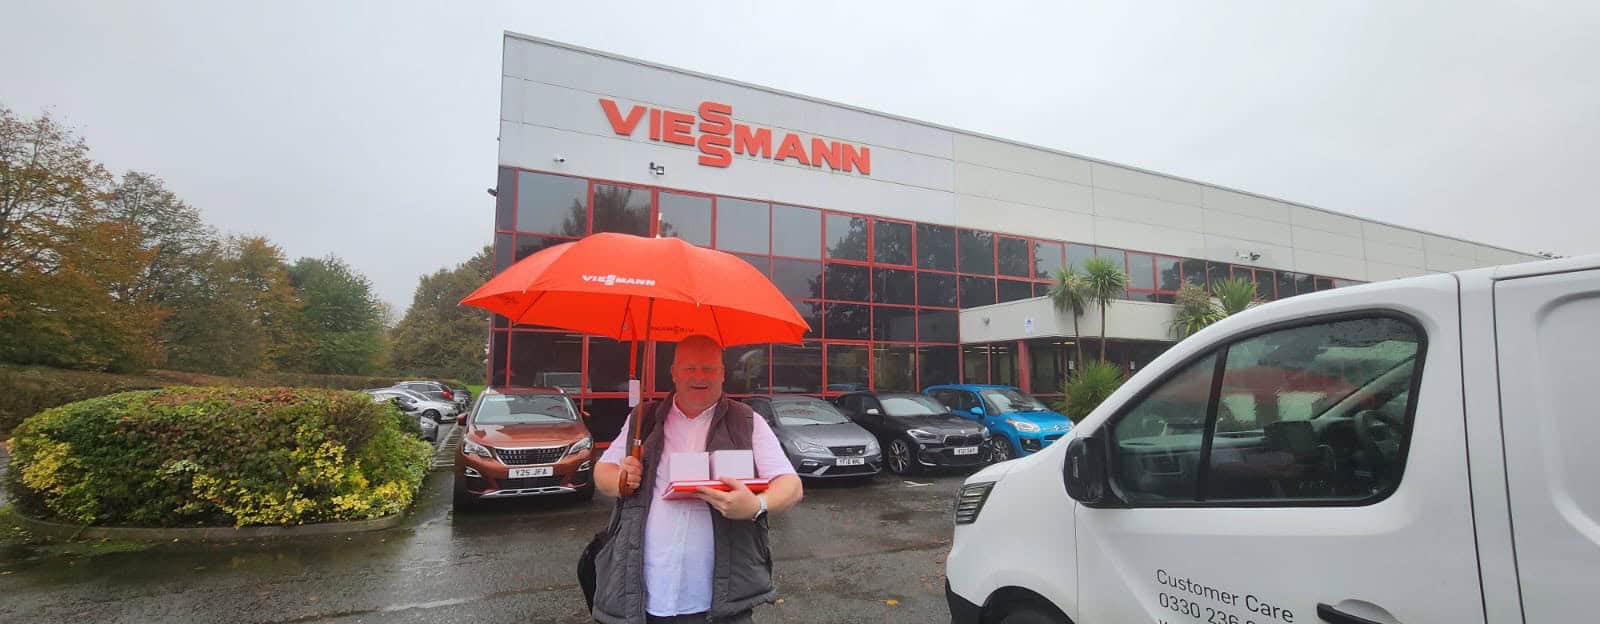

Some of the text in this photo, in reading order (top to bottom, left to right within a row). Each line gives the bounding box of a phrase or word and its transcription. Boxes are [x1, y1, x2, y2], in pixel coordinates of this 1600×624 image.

[598, 97, 870, 175] VIESSMANN
[582, 274, 656, 286] VIESSMANN
[1156, 568, 1294, 623] Customer Care
[1159, 592, 1201, 619] 0330
